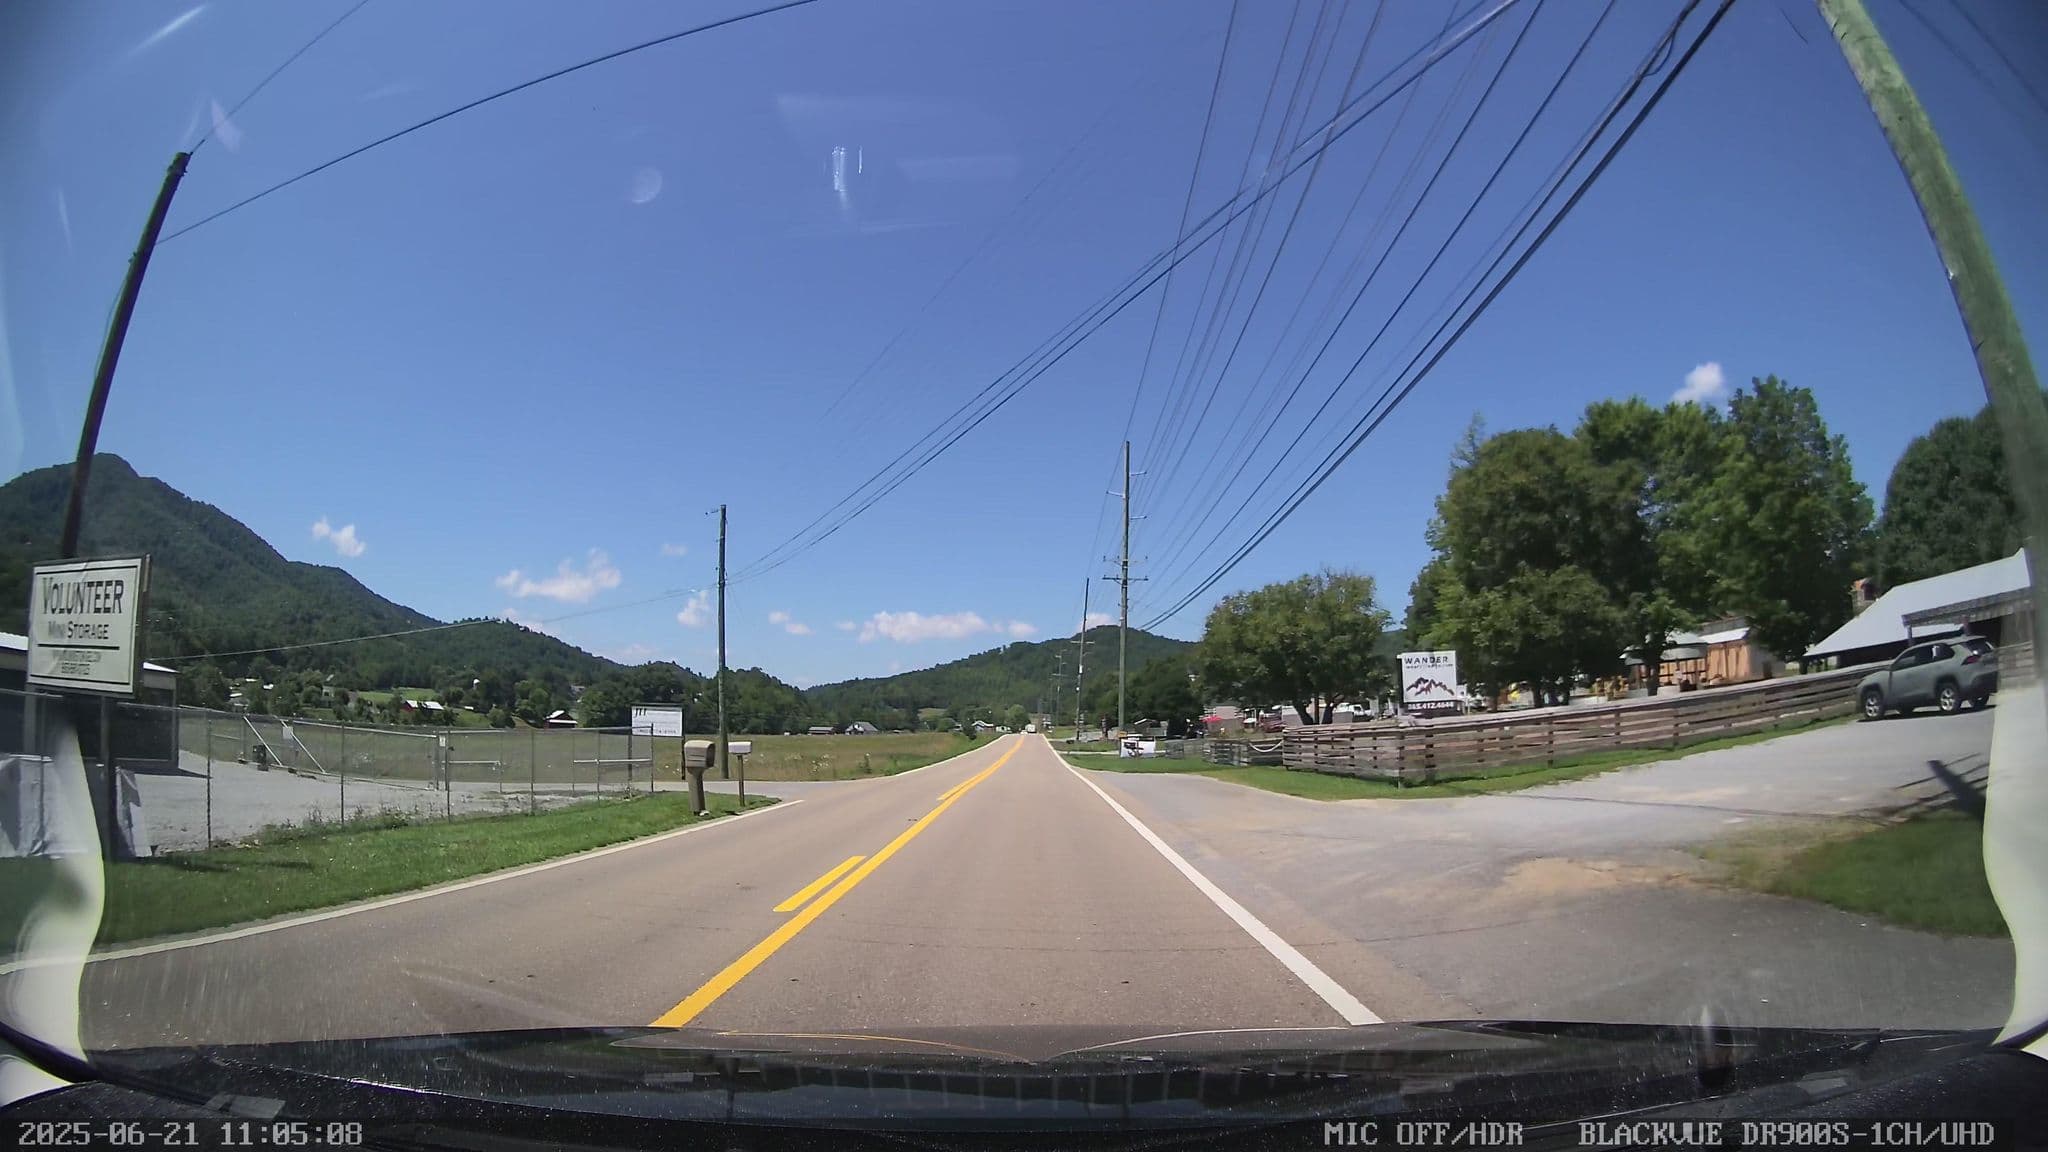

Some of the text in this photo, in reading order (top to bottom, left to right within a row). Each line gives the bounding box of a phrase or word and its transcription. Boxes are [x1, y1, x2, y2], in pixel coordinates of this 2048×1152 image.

[42, 577, 124, 614] VOLUNTEER
[67, 620, 109, 639] STORAGE
[1405, 656, 1448, 664] WANDER
